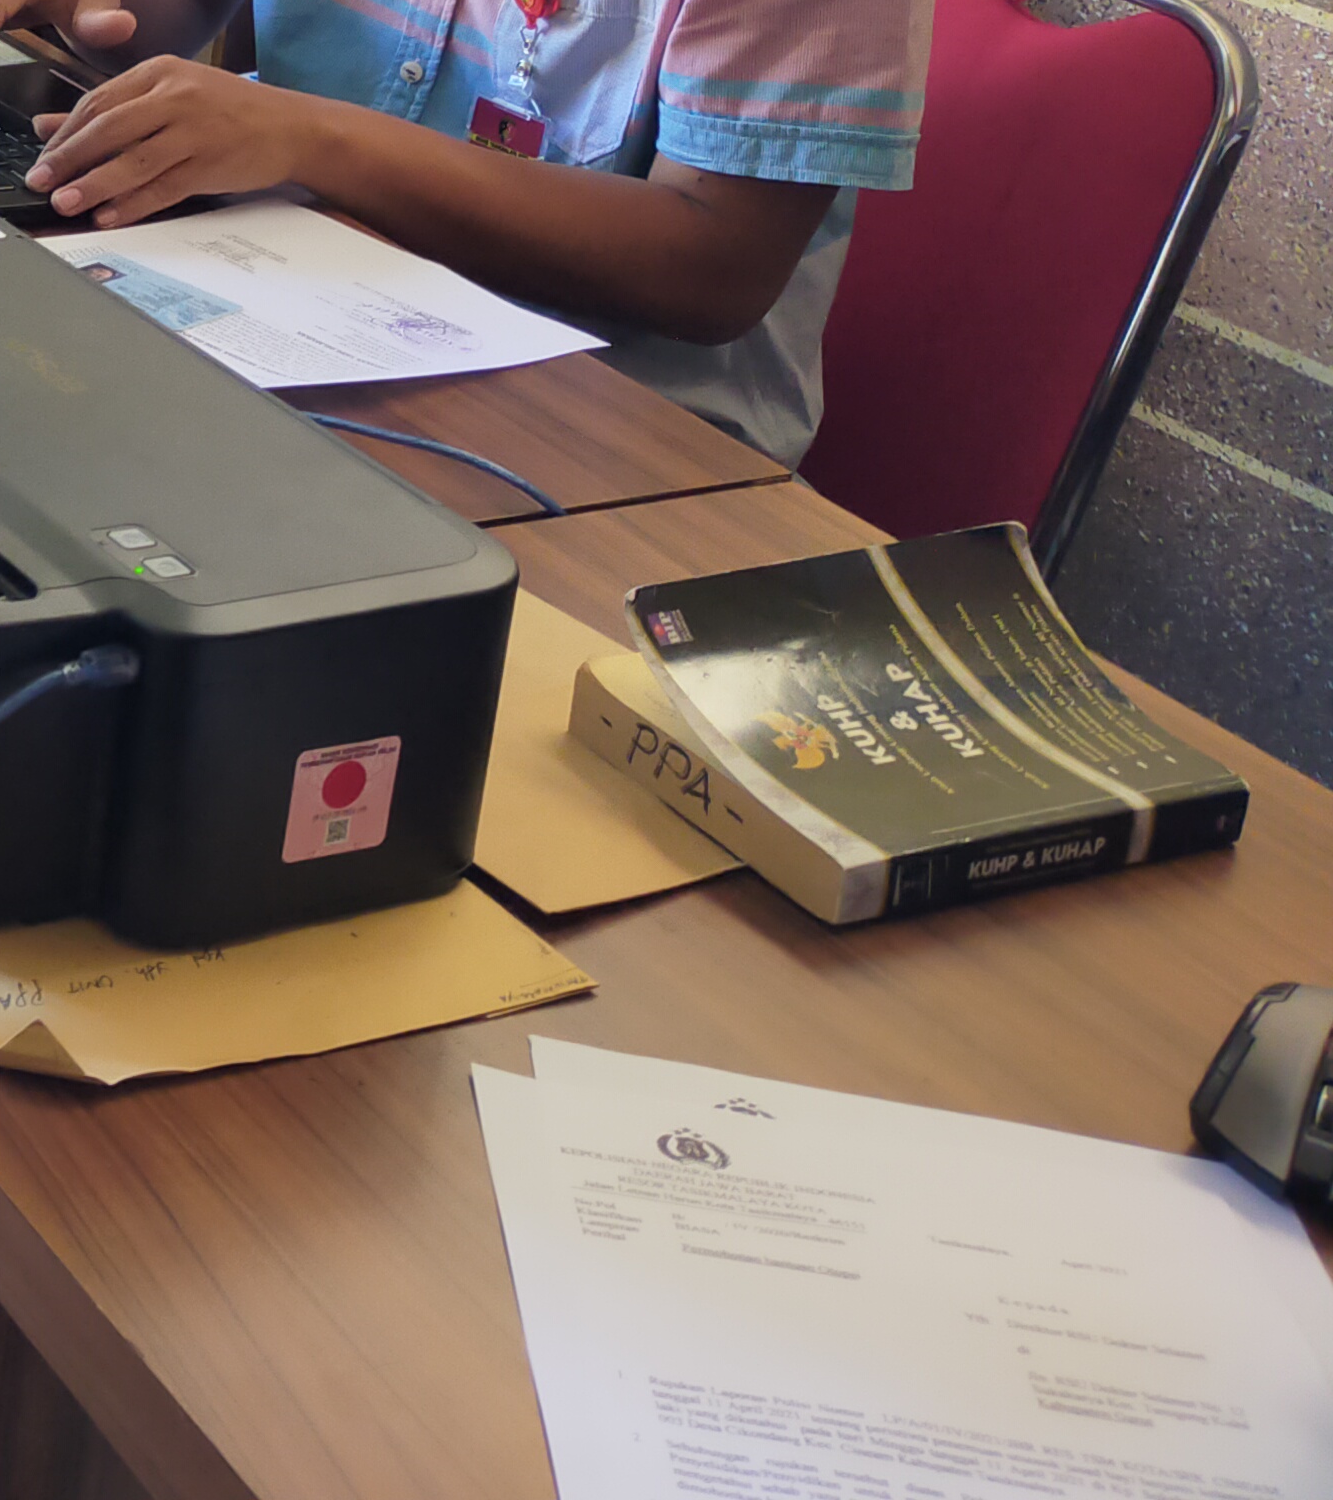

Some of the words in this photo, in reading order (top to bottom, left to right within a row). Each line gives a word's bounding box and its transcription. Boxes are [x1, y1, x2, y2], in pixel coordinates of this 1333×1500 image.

[817, 694, 897, 765] KUHP
[885, 663, 985, 758] KUHAP
[889, 710, 919, 731] &
[626, 722, 712, 815] PPA
[968, 853, 1019, 880] KUHP
[1021, 850, 1037, 869] &
[1040, 836, 1107, 864] KUHAP
[66, 975, 114, 997] UNIT
